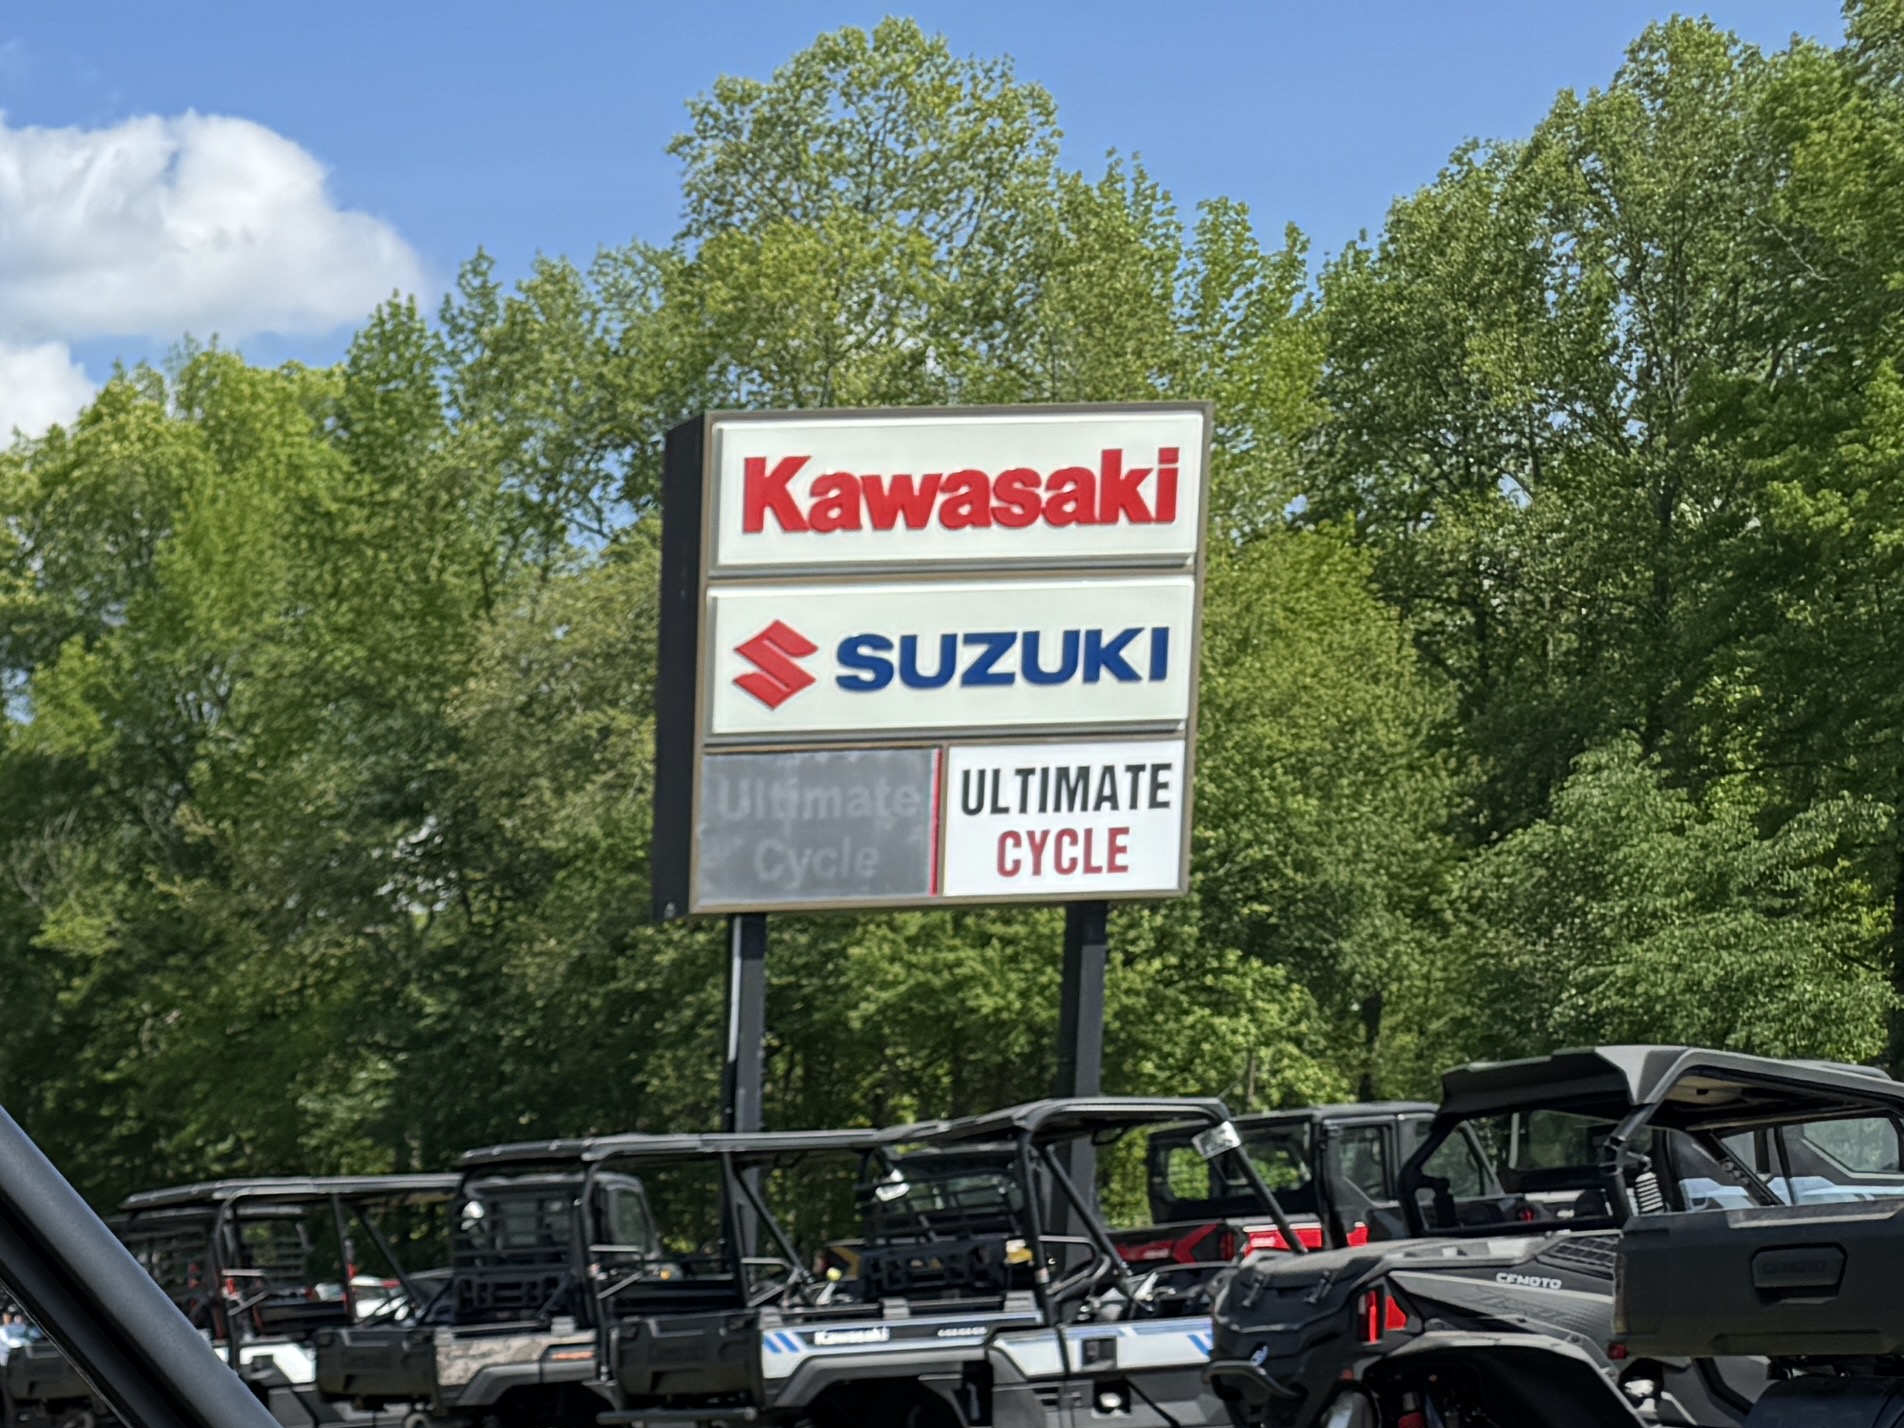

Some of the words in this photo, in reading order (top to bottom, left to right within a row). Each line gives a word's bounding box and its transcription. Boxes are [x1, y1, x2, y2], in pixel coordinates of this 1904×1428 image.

[743, 446, 1180, 533] Kawasaki
[835, 626, 1170, 693] SUZUKI
[718, 775, 923, 822] Ultimate
[961, 762, 1172, 816] ULTIMATE
[754, 835, 879, 883] Cycle
[996, 826, 1130, 877] CYCLE
[1496, 1272, 1562, 1290] CFMOTO
